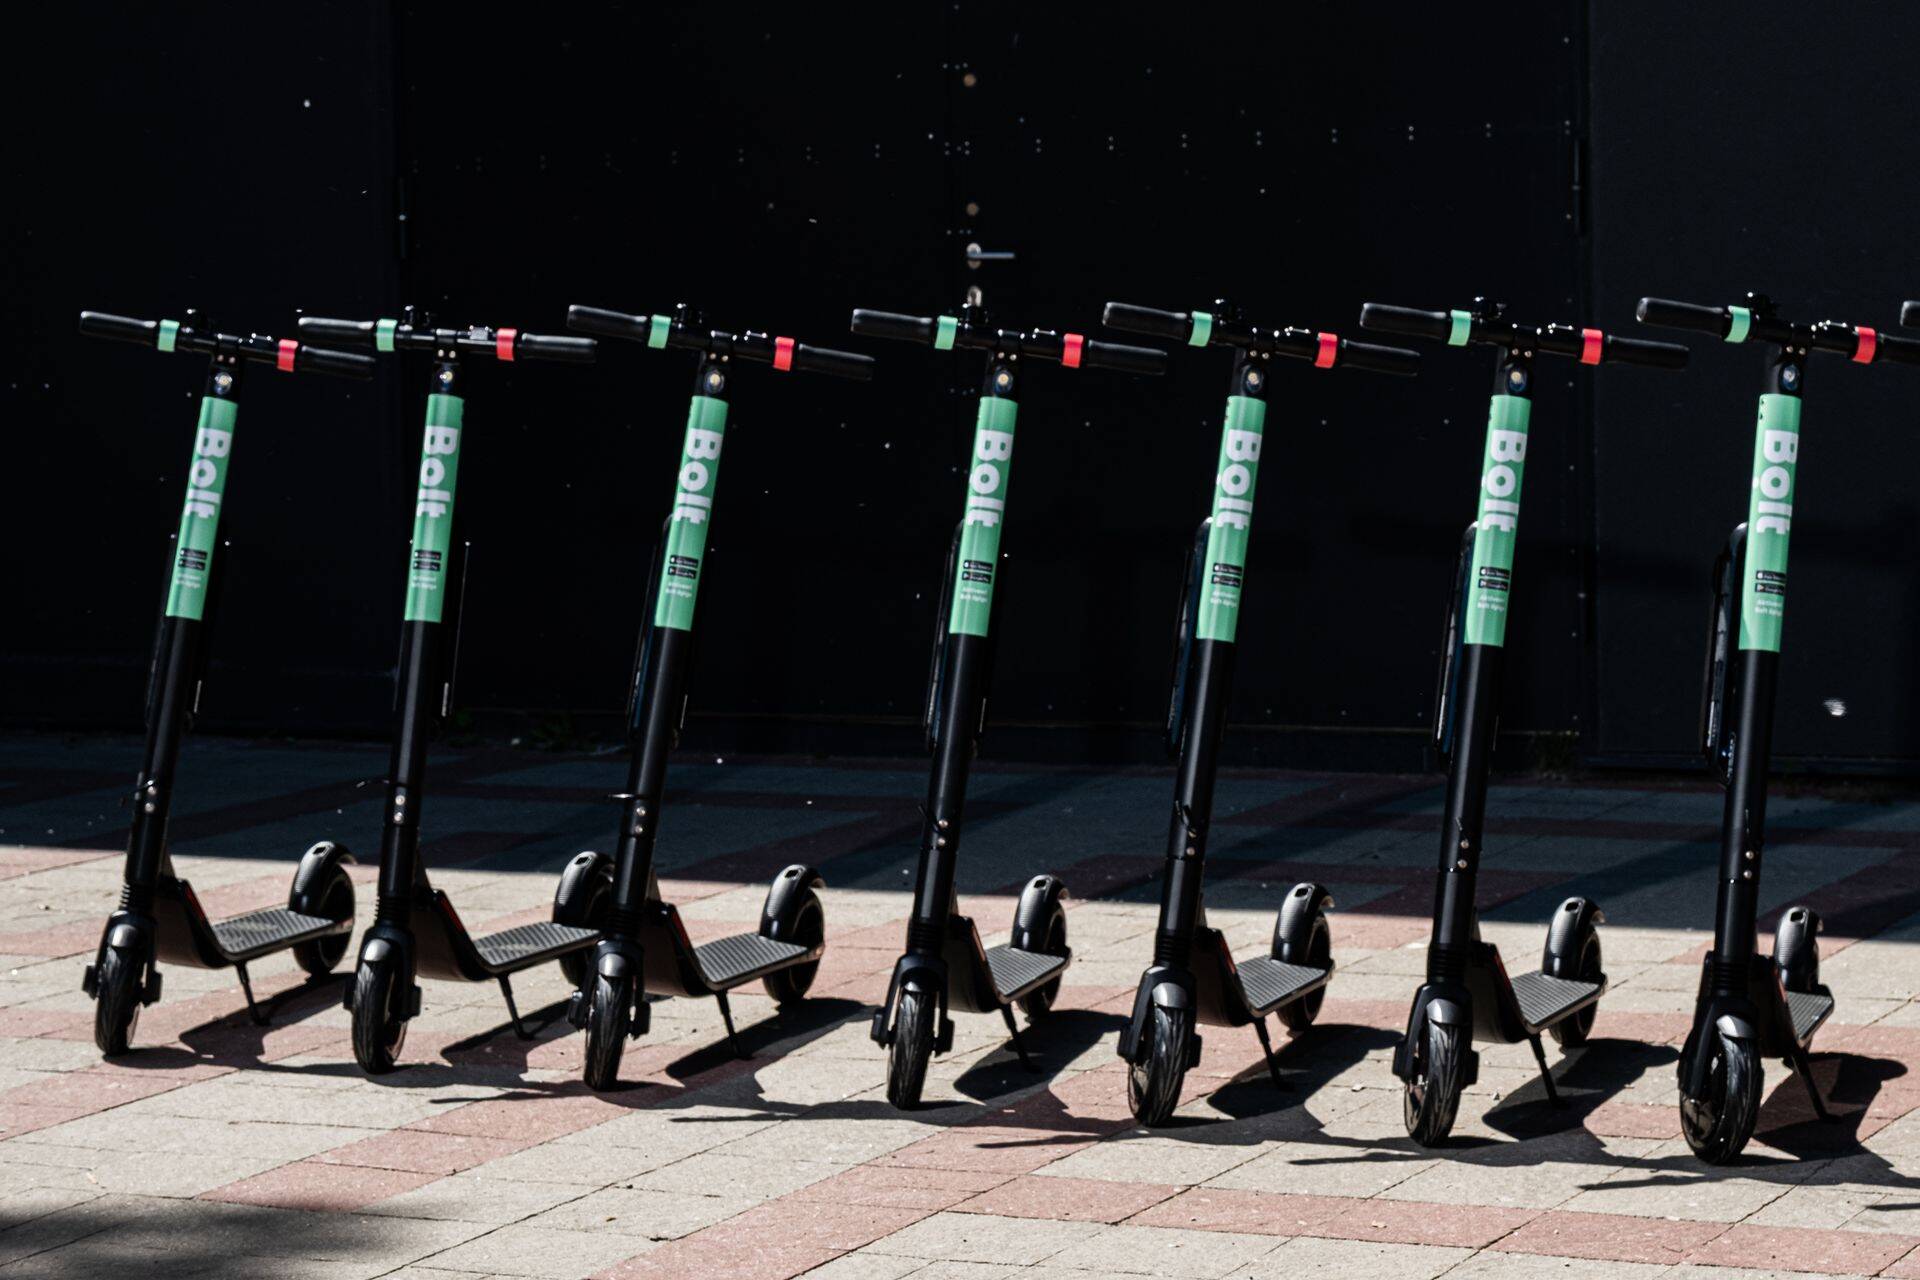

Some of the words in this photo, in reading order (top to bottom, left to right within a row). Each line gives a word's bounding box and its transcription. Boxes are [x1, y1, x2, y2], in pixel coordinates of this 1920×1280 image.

[184, 427, 232, 518] Bolt
[416, 425, 459, 517] Bolt
[673, 427, 723, 524] Bolt
[966, 428, 1013, 527] Bolt
[1216, 429, 1262, 530] Bolt
[1482, 429, 1527, 532] Bolt
[1756, 430, 1799, 534] Bolt
